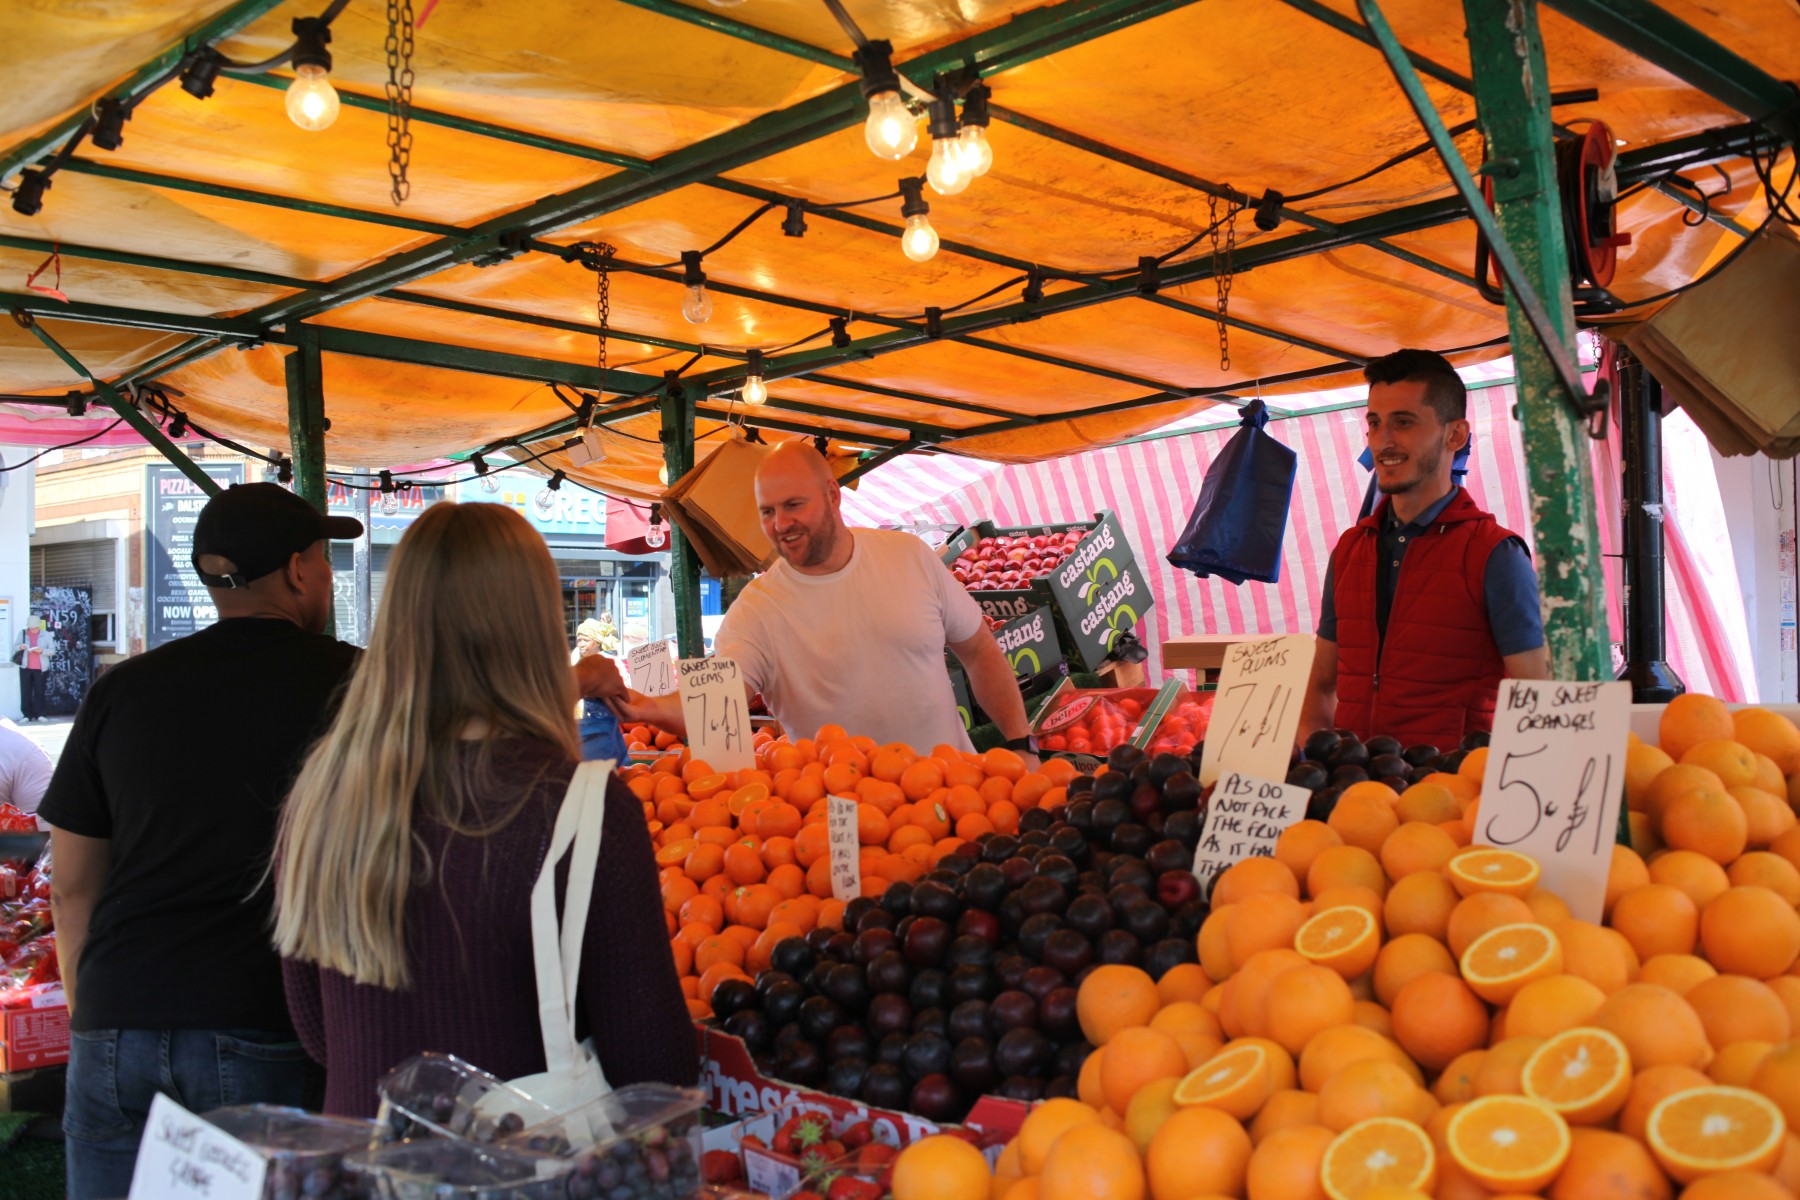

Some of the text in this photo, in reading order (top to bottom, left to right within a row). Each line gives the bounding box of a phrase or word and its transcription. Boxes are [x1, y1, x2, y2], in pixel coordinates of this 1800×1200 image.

[177, 499, 208, 513] DALST
[533, 491, 606, 525] GREG
[1059, 523, 1116, 589] castang
[163, 605, 219, 619] NOW OPE
[1080, 570, 1136, 636] castang
[996, 614, 1045, 655] stang
[1231, 636, 1288, 663] SWEET
[1239, 648, 1290, 677] PLUMS
[632, 662, 652, 696] 7
[680, 660, 737, 679] SWEET JUICY
[689, 671, 725, 688] CLEMS
[1507, 681, 1605, 714] VERY SWEET
[687, 692, 707, 747] 7
[1217, 682, 1258, 763] 7
[1516, 710, 1596, 734] ORANGES
[1258, 783, 1283, 799] DO
[1485, 744, 1548, 846] 5
[1215, 798, 1292, 819] NOT PICK
[1211, 815, 1289, 839] THE FRUI
[1202, 834, 1221, 853] AS
[1229, 843, 1247, 856] IT
